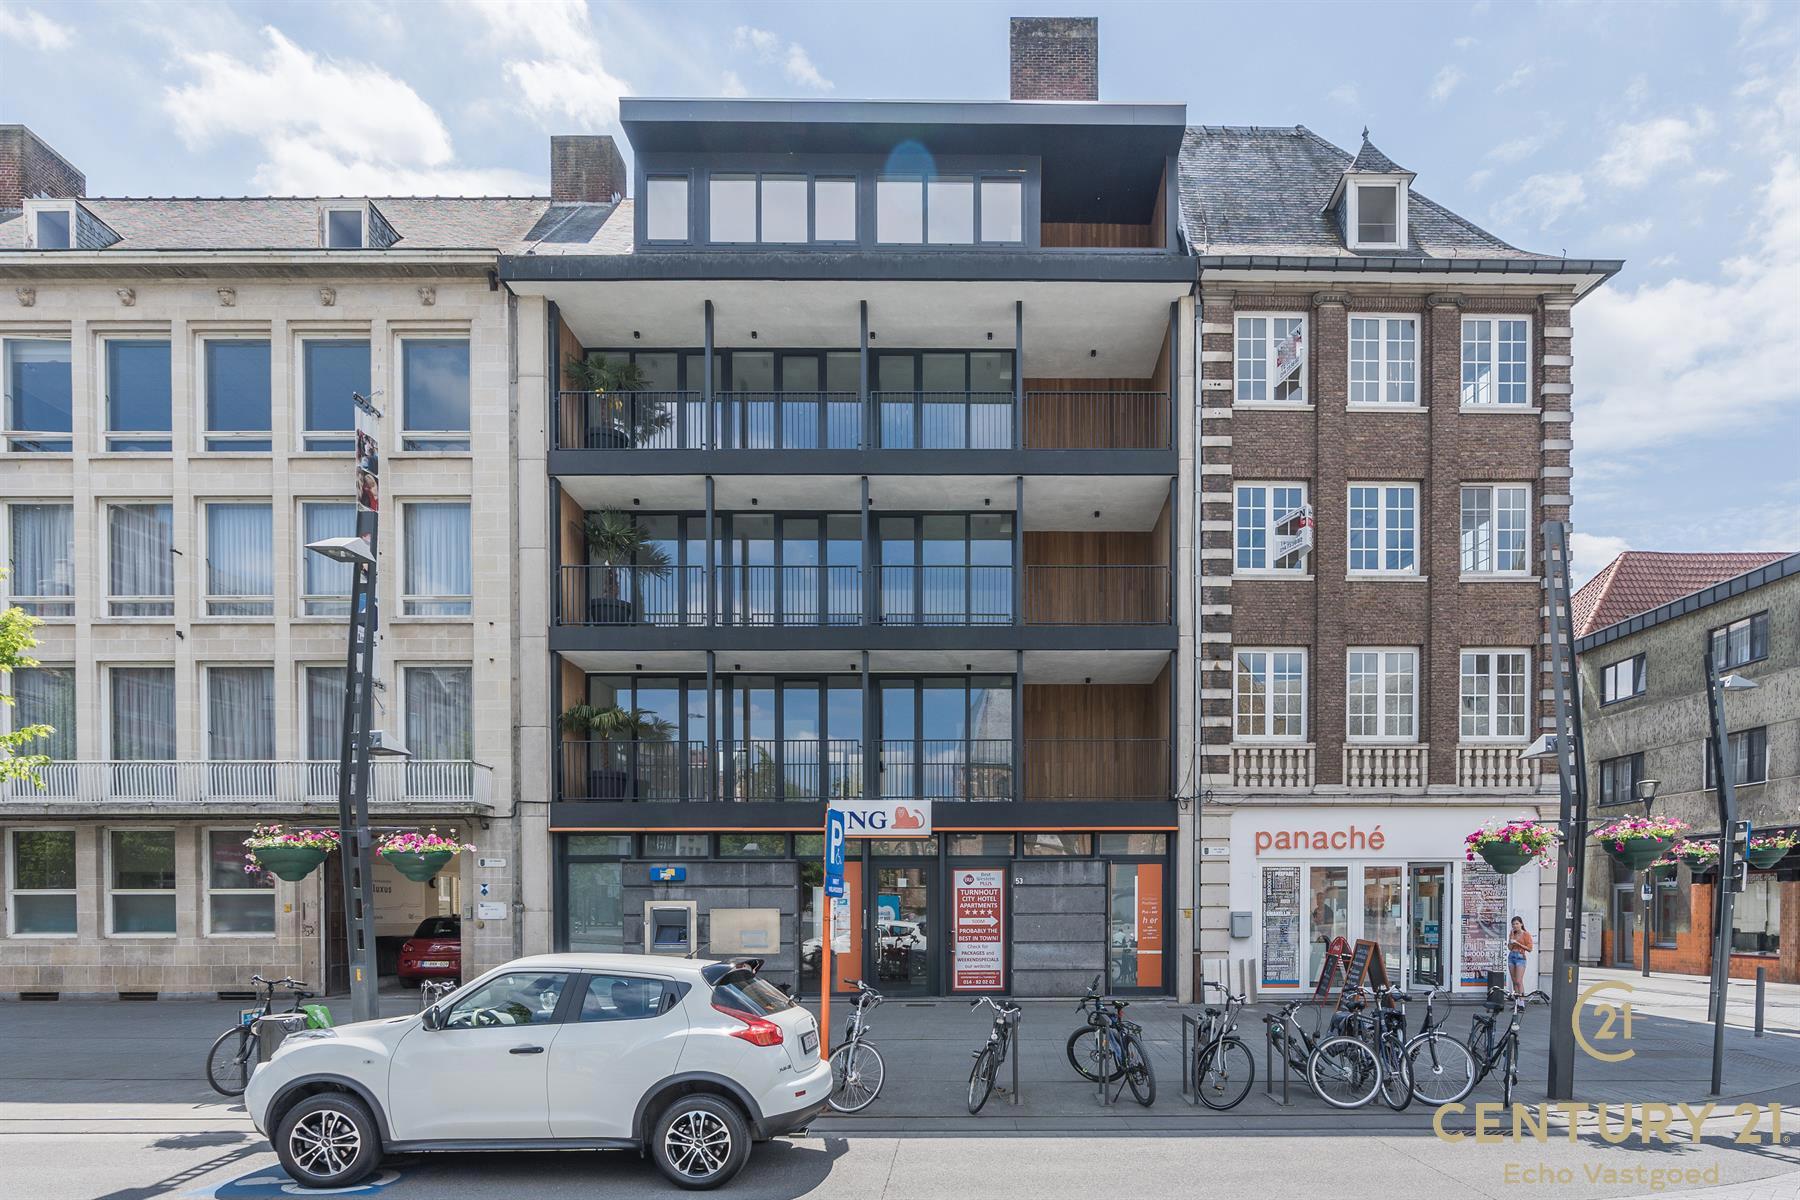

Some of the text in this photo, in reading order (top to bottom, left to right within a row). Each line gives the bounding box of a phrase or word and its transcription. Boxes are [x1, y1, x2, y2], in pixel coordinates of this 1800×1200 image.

[841, 811, 888, 829] NG
[831, 819, 843, 864] P
[1255, 825, 1385, 855] panaché
[1015, 877, 1024, 885] 53
